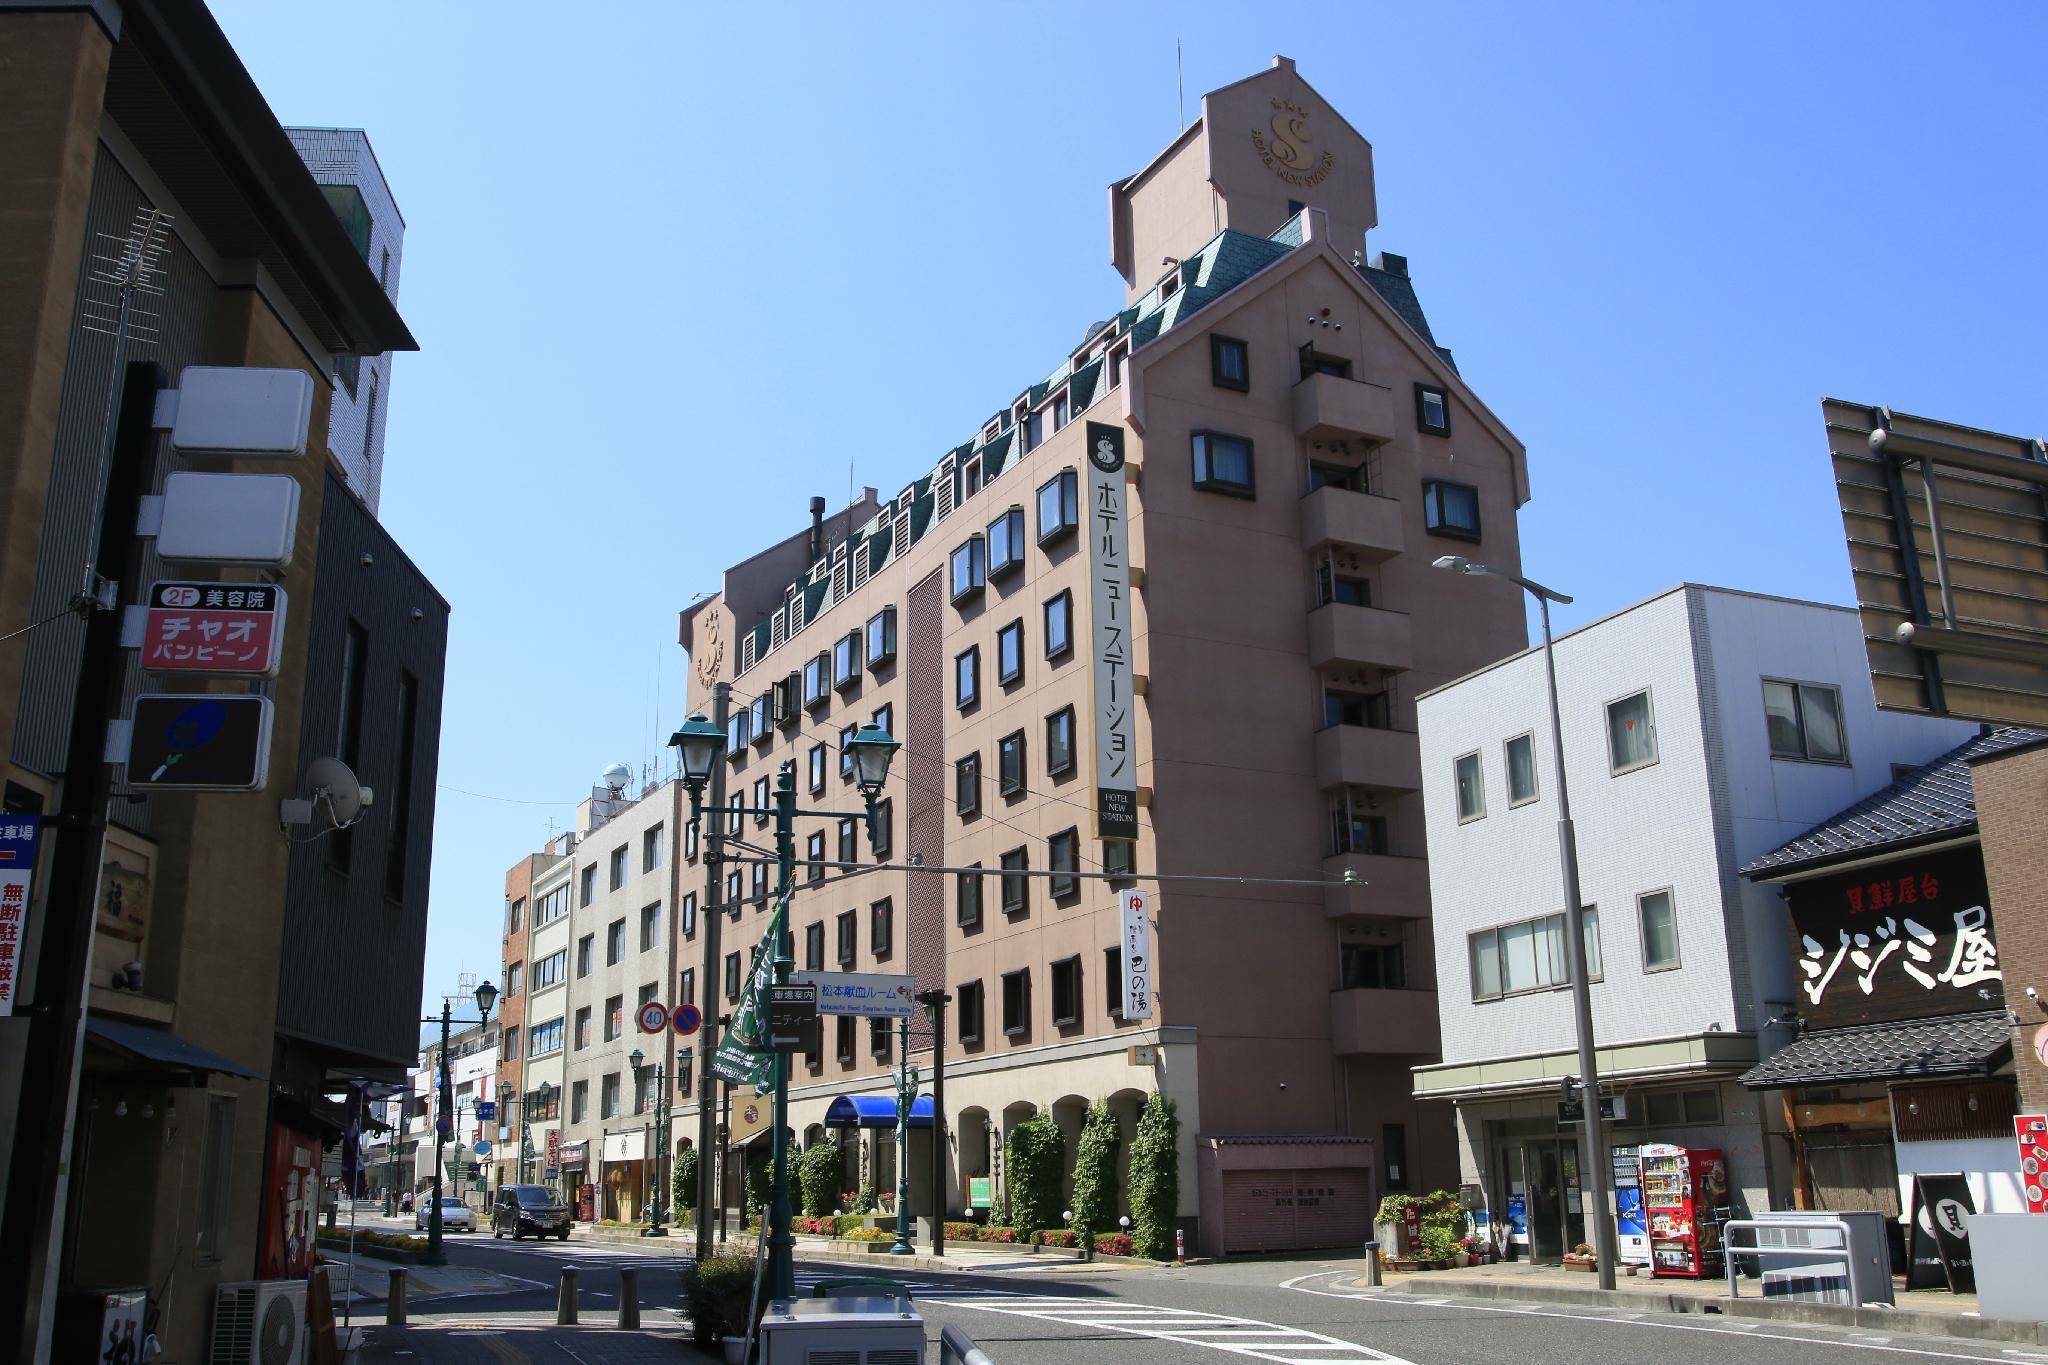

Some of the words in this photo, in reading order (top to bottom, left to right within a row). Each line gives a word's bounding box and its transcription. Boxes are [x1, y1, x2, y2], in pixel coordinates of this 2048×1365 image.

[168, 589, 193, 605] 2F
[205, 590, 266, 608] 美容院
[161, 617, 257, 642] チャオ
[1096, 482, 1126, 778] ホテルニューステーション
[153, 643, 258, 662] バンビーノ
[1105, 793, 1128, 803] HOTEL
[1108, 802, 1127, 812] NEW
[1102, 812, 1134, 822] STATION
[0, 824, 34, 840] 車場
[1800, 906, 2003, 1005] シジミ屋
[771, 990, 813, 1000] 車場案内
[822, 984, 896, 999] 松本献血ルーム
[645, 1011, 662, 1025] 40
[1942, 1204, 1964, 1231] 貝
